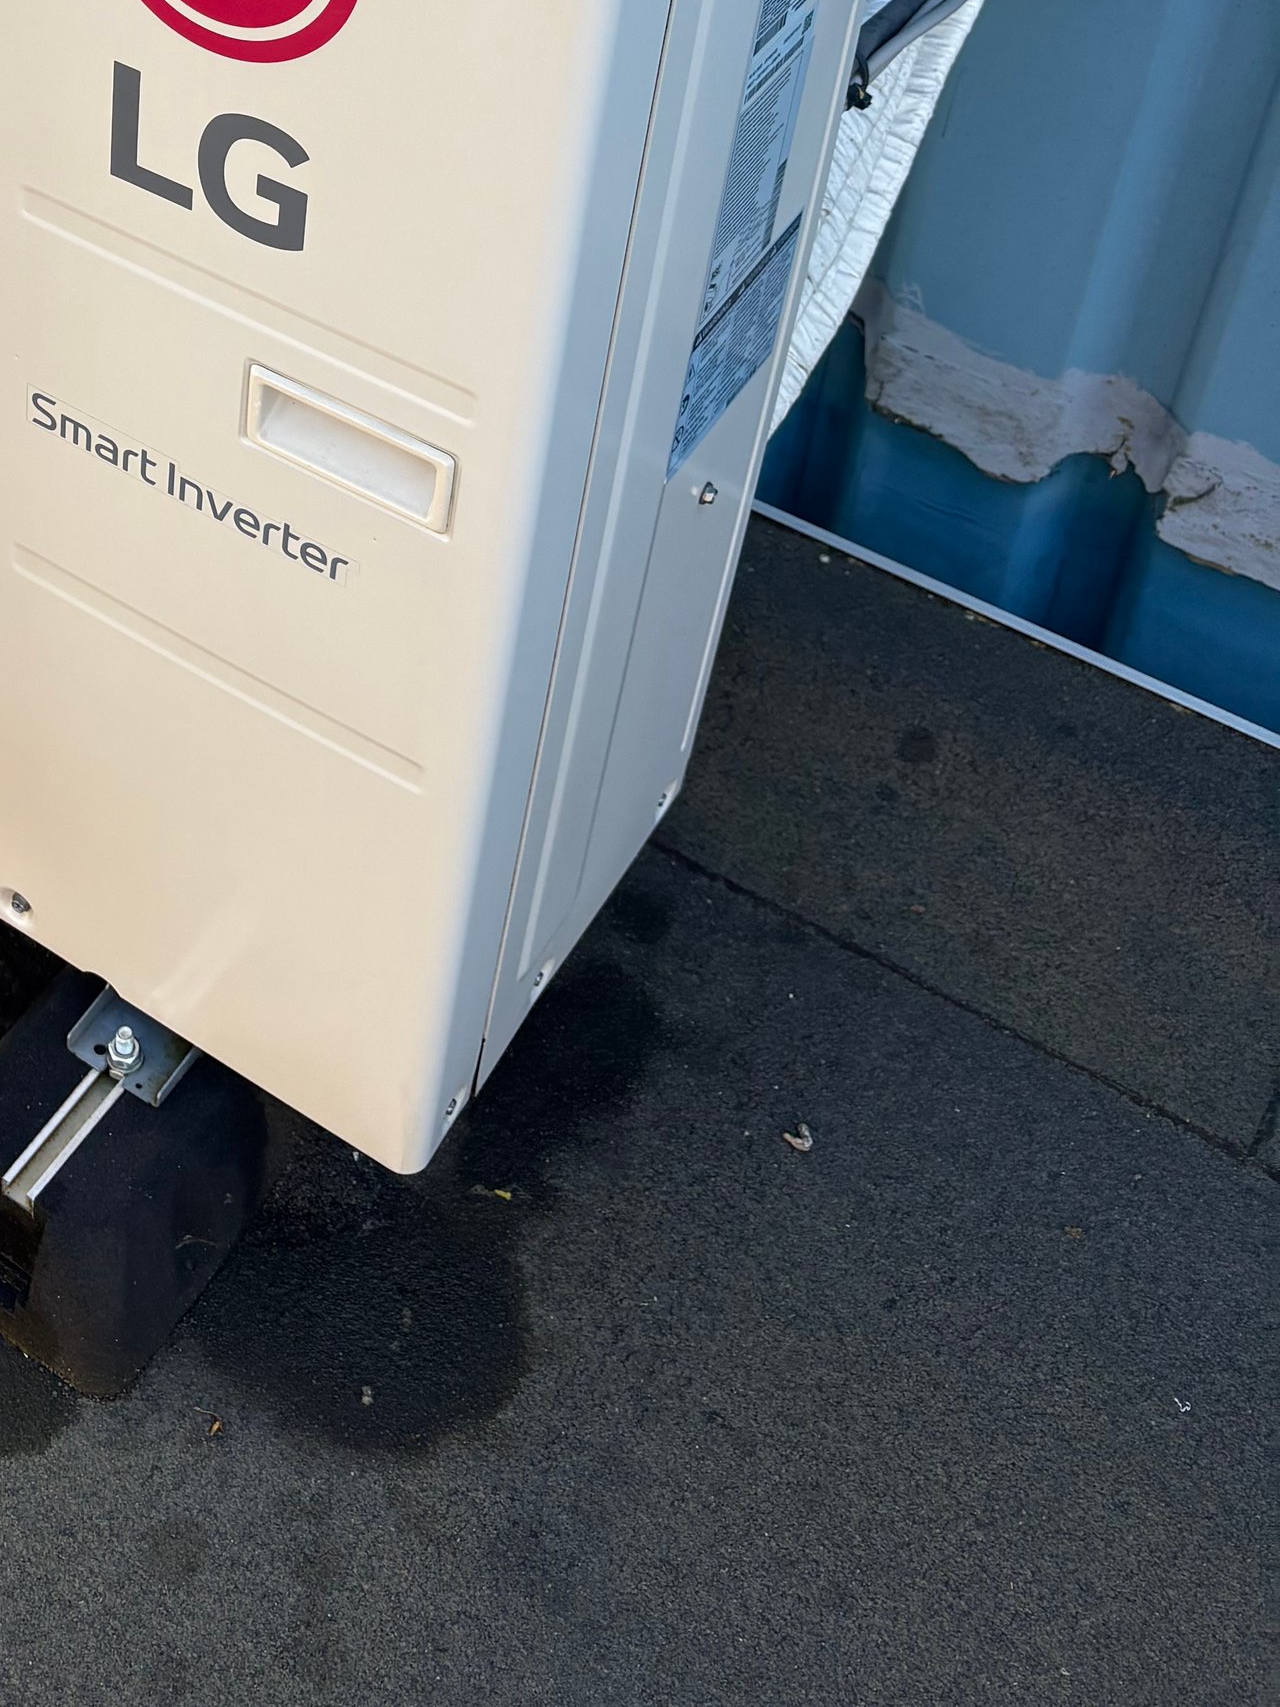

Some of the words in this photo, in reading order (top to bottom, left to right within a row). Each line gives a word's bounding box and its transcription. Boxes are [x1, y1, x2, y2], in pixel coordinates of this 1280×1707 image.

[110, 60, 310, 252] LG
[31, 392, 157, 486] Smart
[167, 461, 349, 581] Inverter
